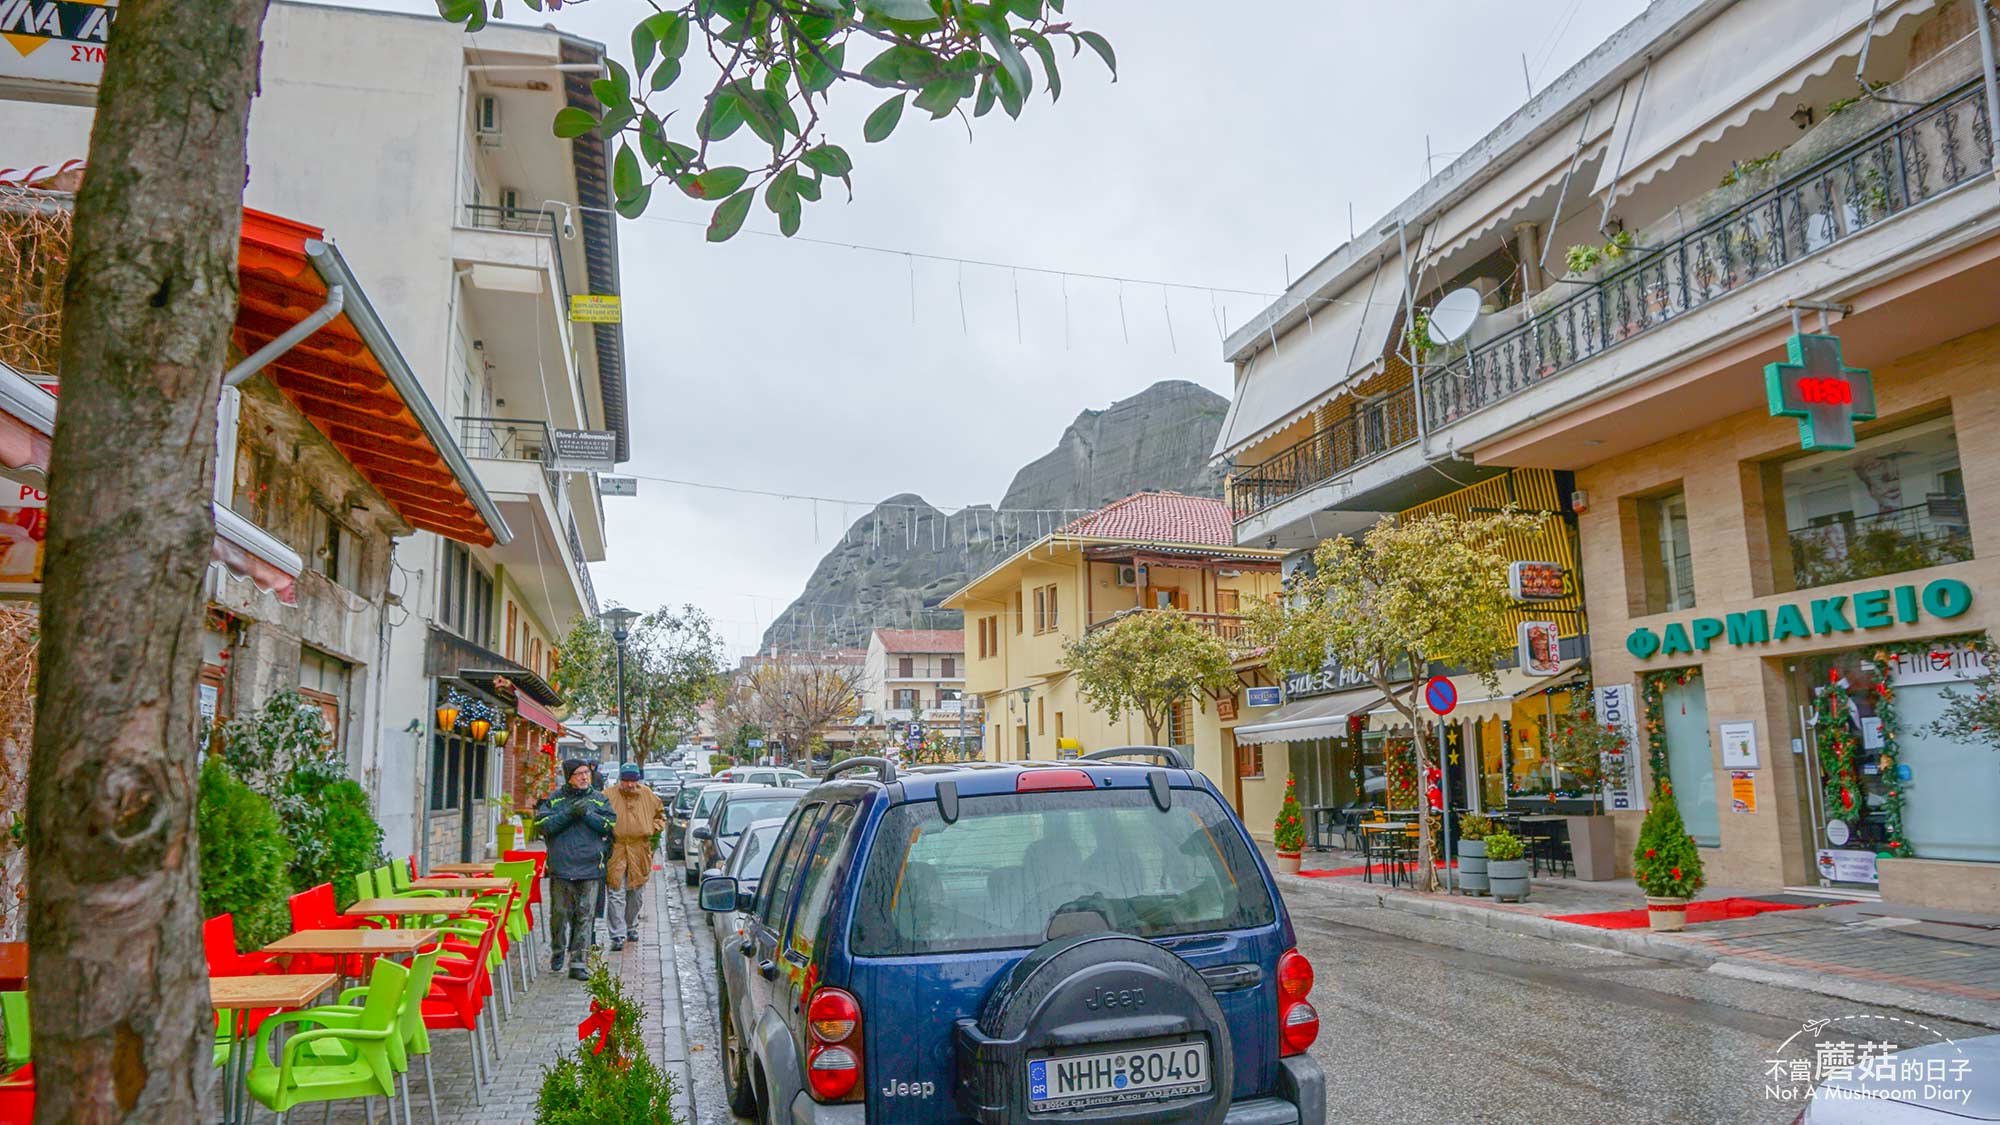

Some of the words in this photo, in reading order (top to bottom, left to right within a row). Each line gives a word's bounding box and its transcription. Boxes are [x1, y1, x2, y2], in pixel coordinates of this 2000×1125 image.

[1798, 376, 1852, 404] 11:51
[1626, 578, 1973, 660] ΦΑΡΜΑΚΕΙΟ
[1548, 623, 1561, 672] GYROS
[1287, 670, 1336, 695] SILVER
[1085, 986, 1145, 1011] Jeep
[882, 1079, 935, 1100] Jeep
[1032, 1085, 1046, 1095] GR
